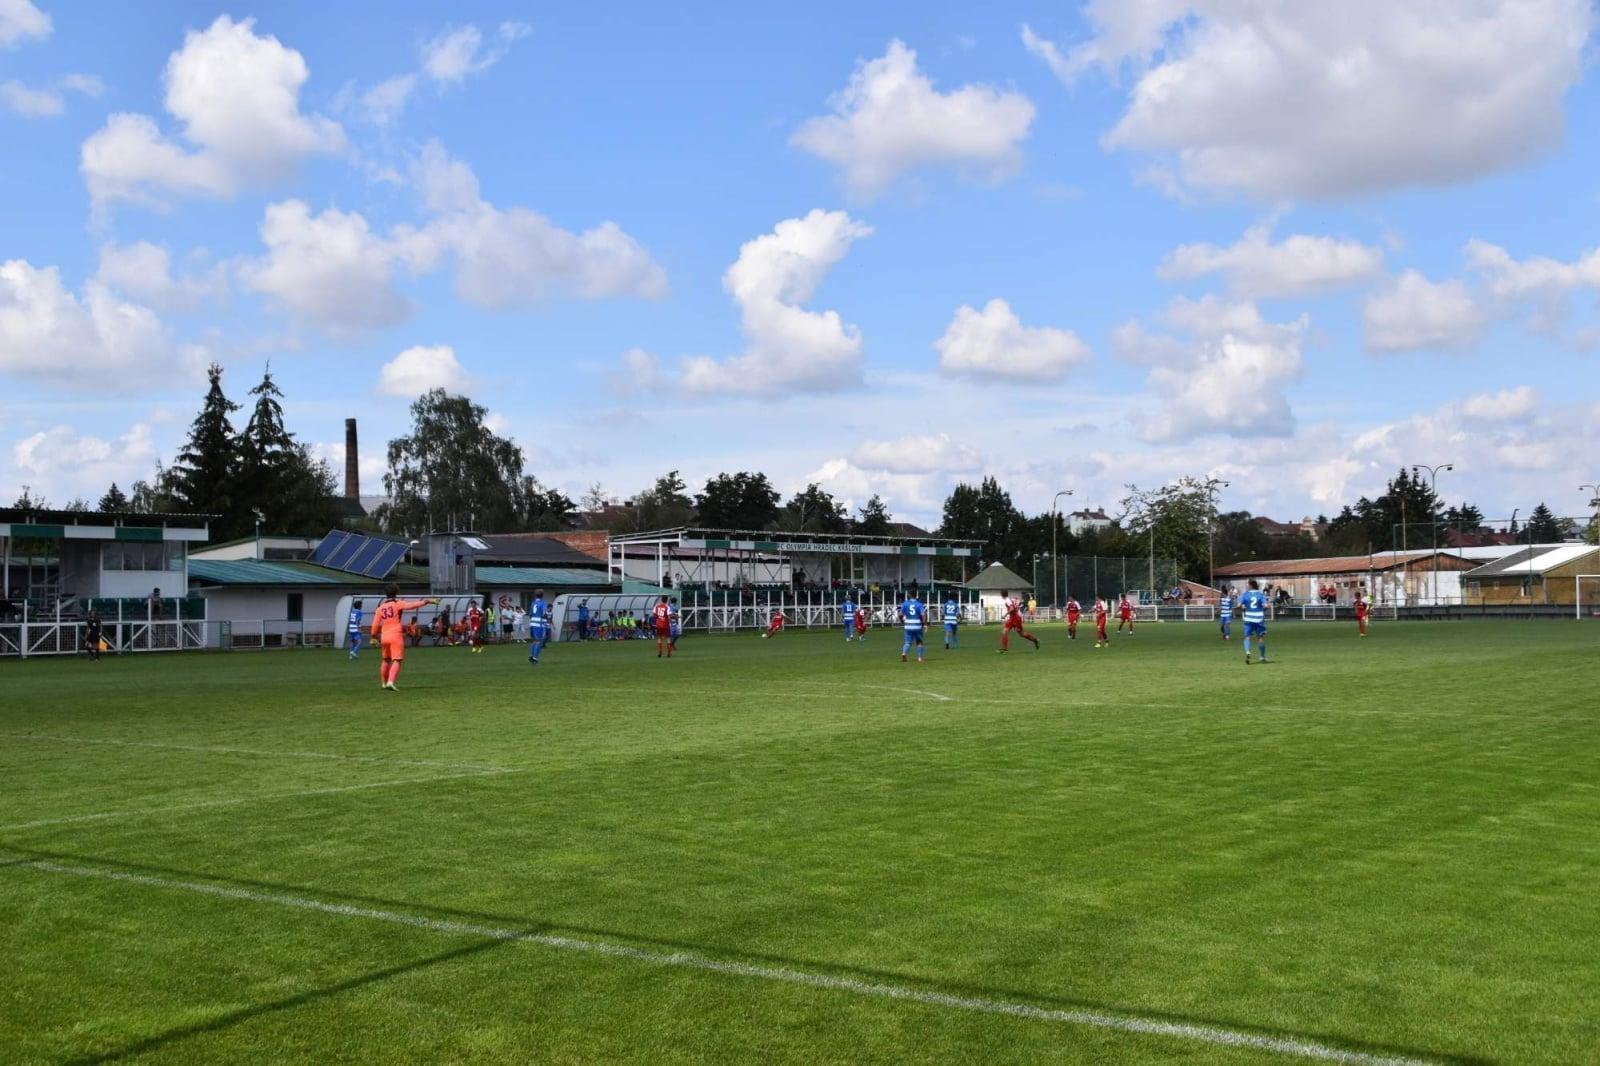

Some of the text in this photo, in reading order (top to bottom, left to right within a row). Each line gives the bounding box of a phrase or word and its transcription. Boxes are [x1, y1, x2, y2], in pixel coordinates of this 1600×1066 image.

[1250, 596, 1257, 609] 2
[381, 606, 394, 620] 33
[658, 607, 665, 616] 16
[909, 604, 916, 615] 5
[946, 604, 955, 614] 22
